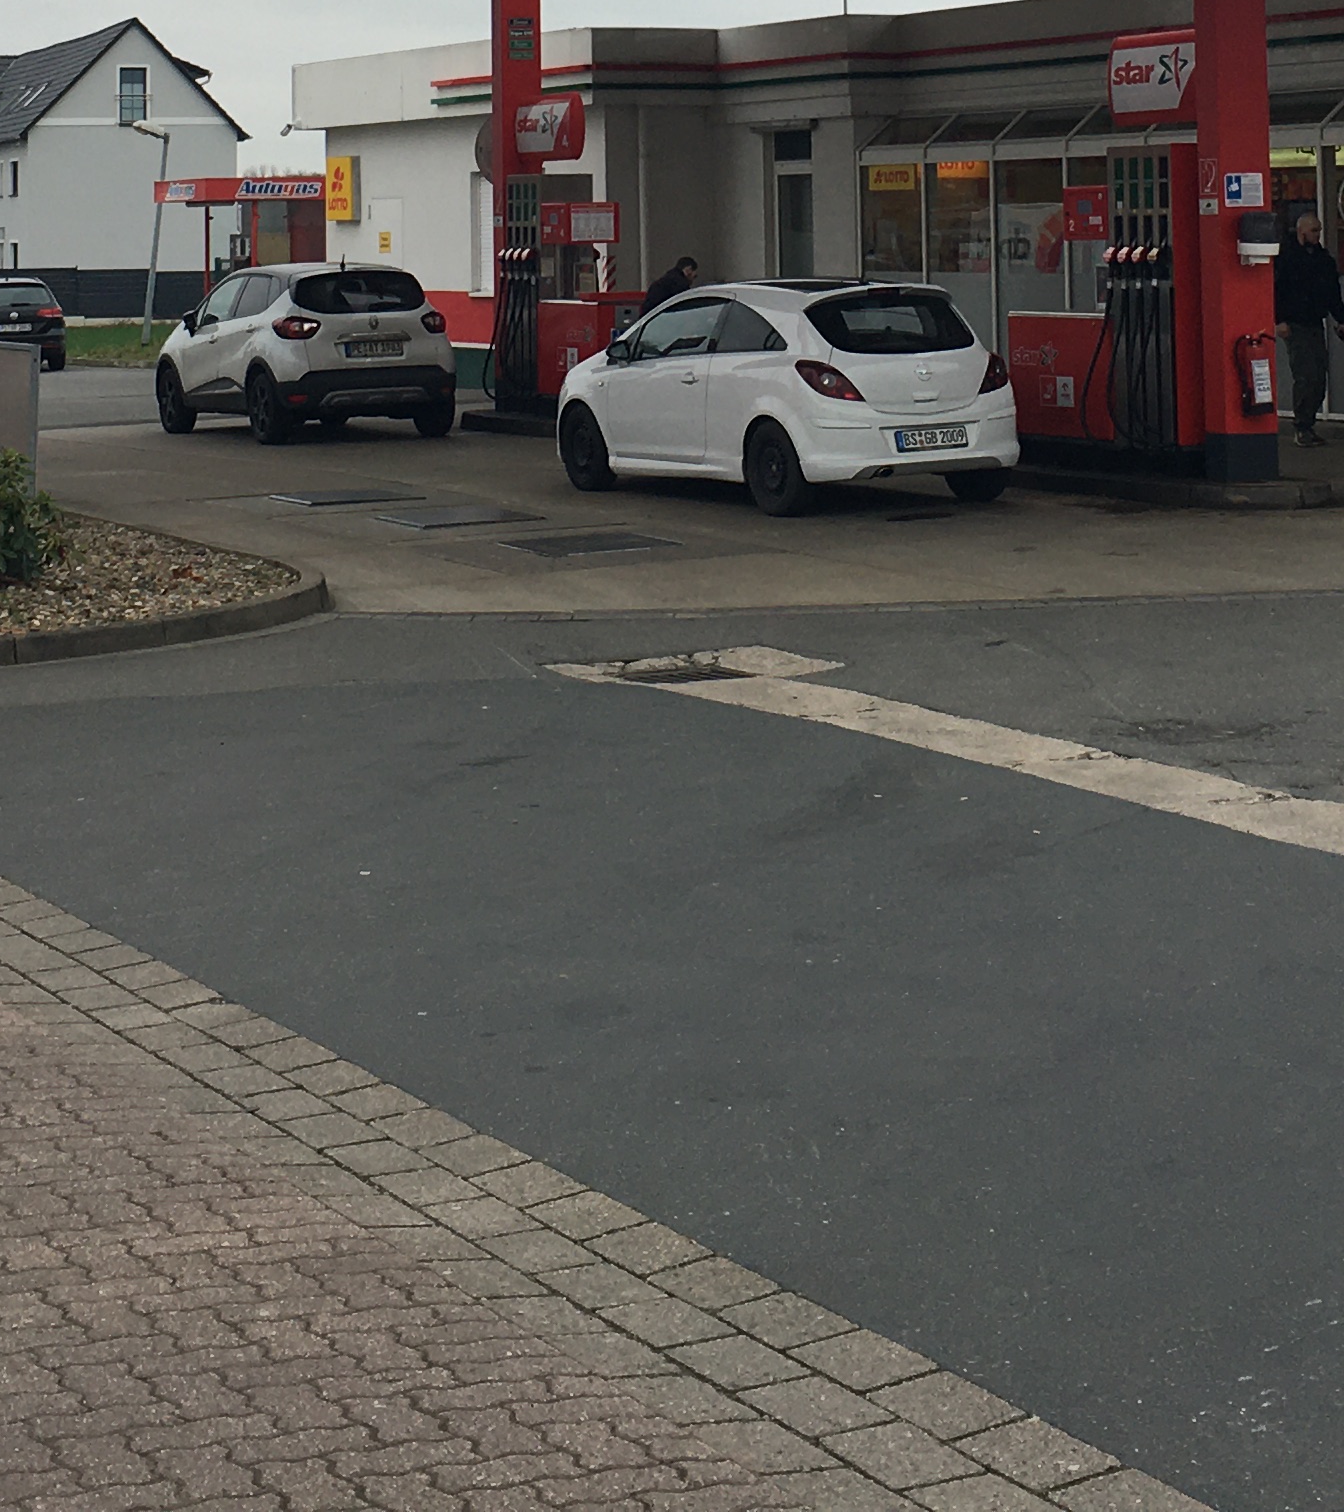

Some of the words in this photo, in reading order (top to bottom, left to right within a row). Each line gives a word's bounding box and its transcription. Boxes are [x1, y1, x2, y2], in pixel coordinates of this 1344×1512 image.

[1112, 60, 1155, 86] star
[517, 114, 540, 134] star
[884, 170, 910, 183] LOTTO
[238, 180, 320, 197] Autogas
[328, 197, 348, 211] LOTTO
[1069, 220, 1075, 232] 2
[903, 432, 918, 446] BS
[939, 428, 965, 444] 2009
